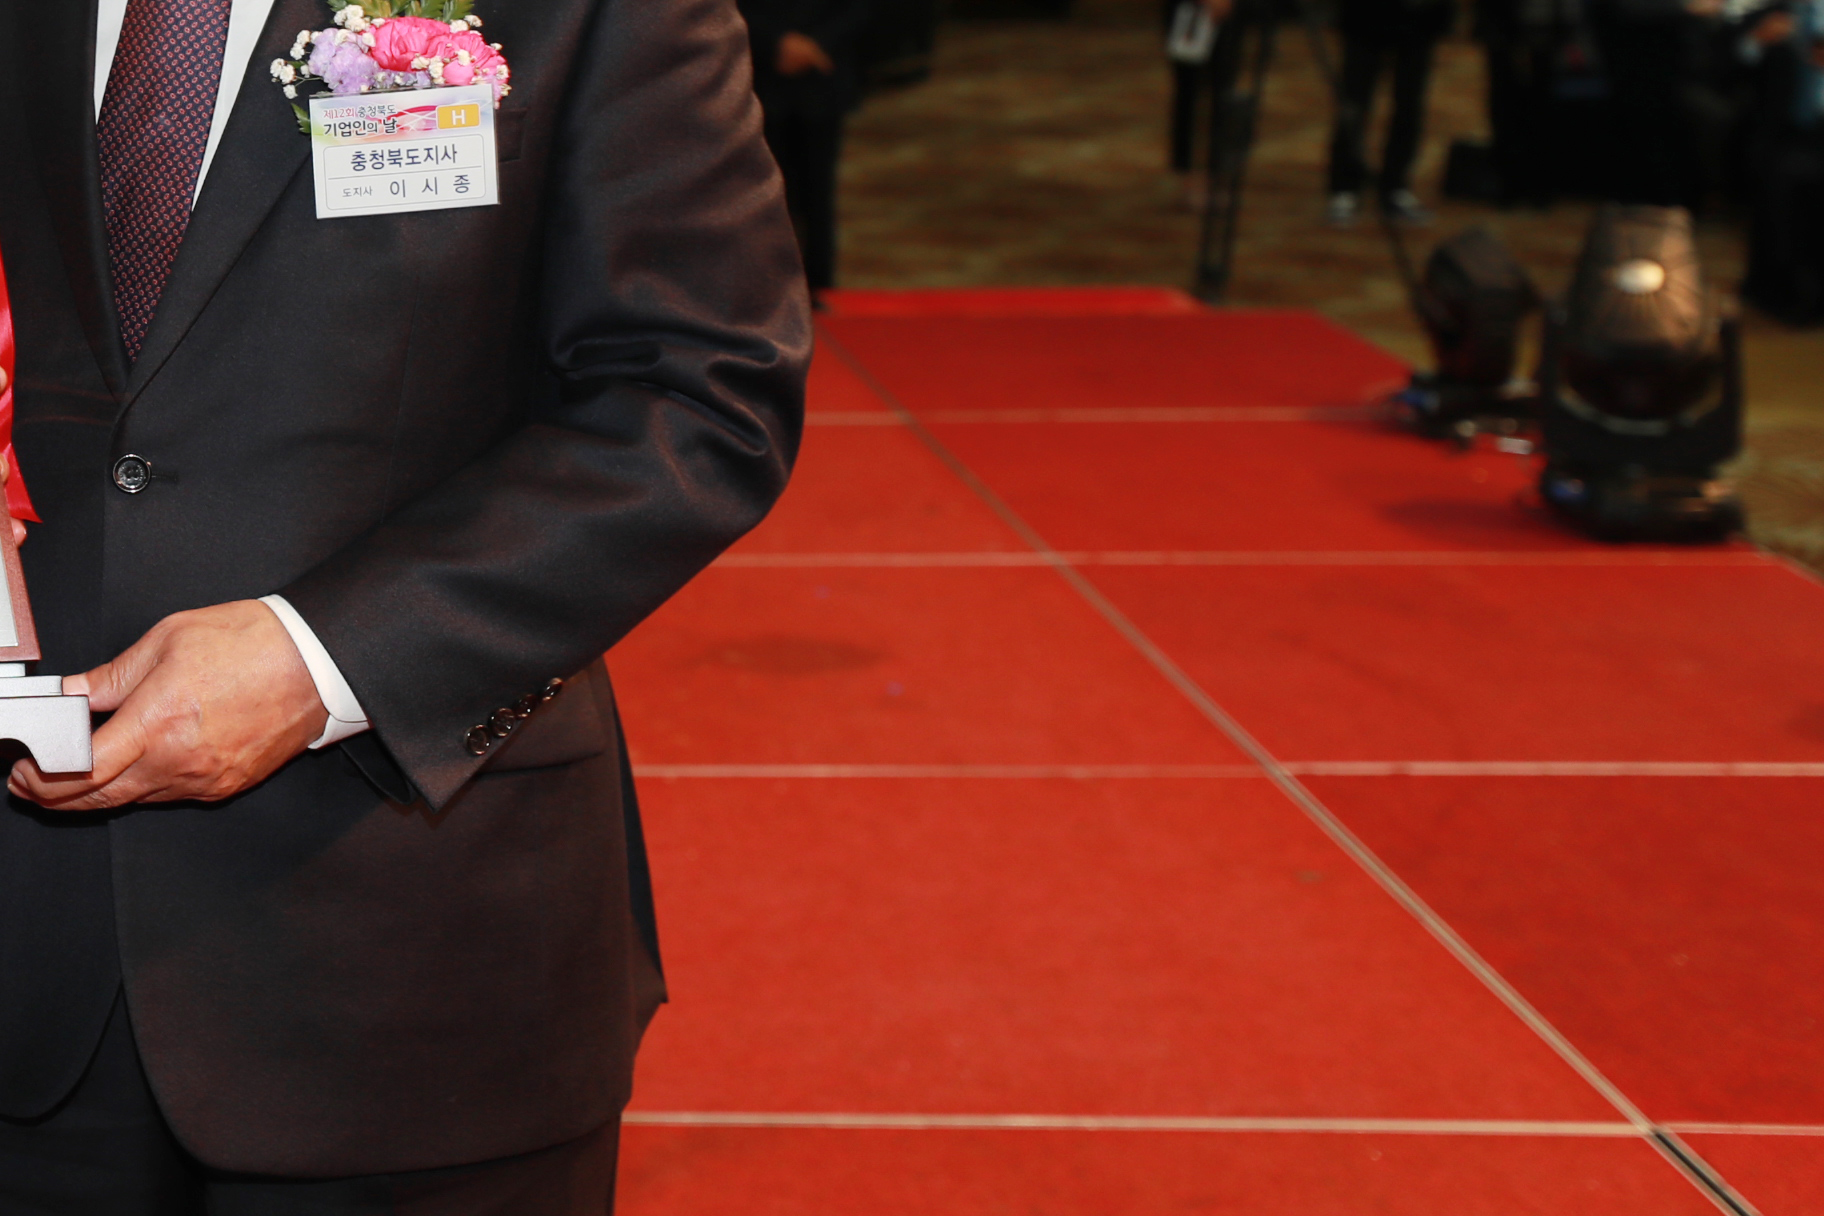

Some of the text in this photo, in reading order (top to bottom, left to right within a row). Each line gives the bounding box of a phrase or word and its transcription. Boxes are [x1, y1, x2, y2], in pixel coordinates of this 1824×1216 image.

[323, 104, 396, 120] 제12회 충청북도
[451, 110, 466, 125] H
[323, 118, 398, 137] 기업인의 날
[350, 143, 458, 172] 충청북도지사
[342, 185, 373, 198] 도지사
